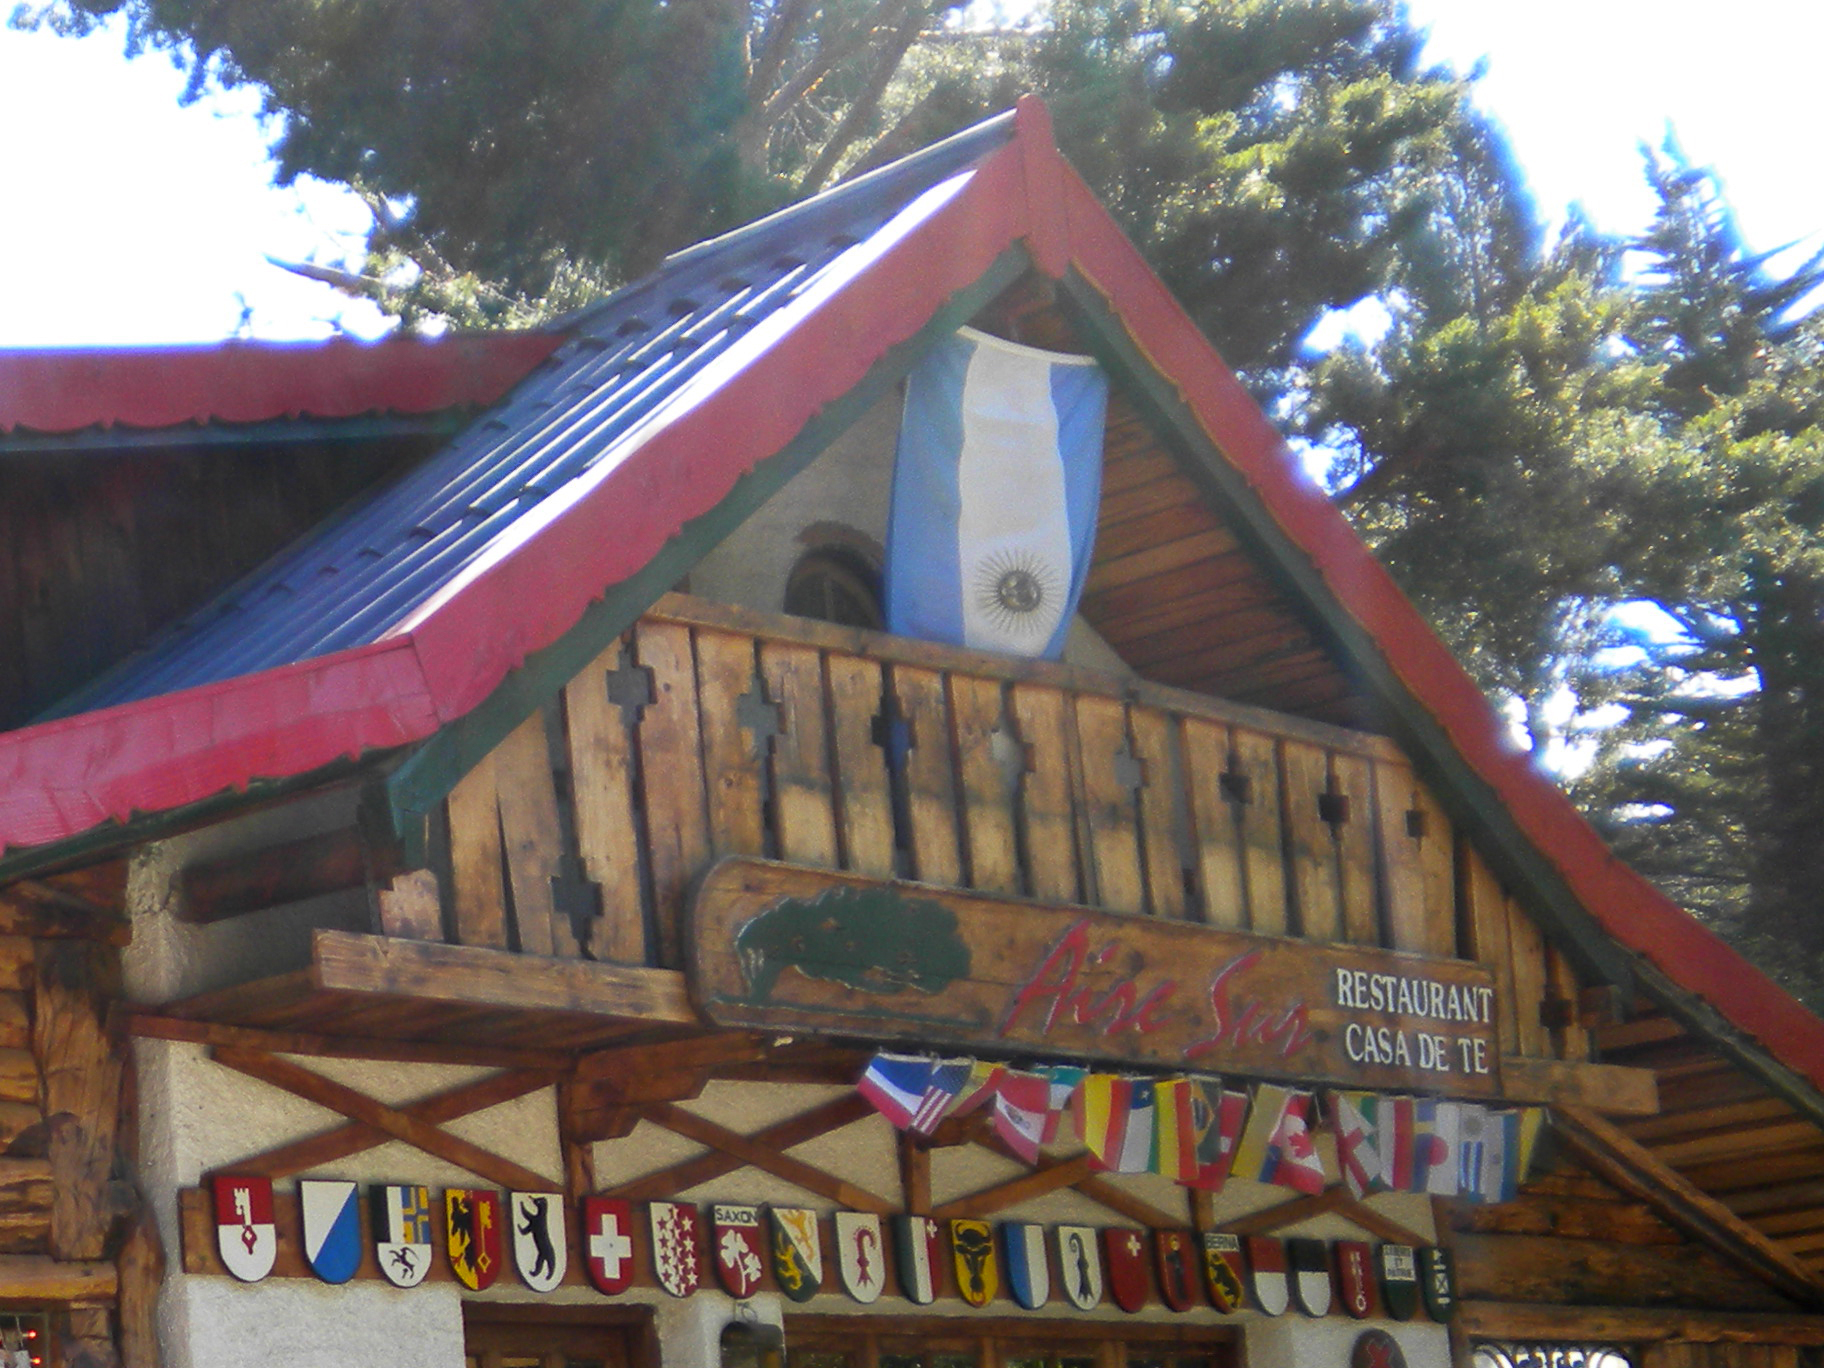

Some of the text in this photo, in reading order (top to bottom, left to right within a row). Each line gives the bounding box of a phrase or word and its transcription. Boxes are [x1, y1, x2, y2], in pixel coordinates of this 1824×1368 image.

[1183, 949, 1313, 1059] Sur
[1336, 967, 1493, 1024] RESTAURANT
[1345, 1023, 1489, 1074] CASA DE TE
[715, 1207, 758, 1223] SAXON
